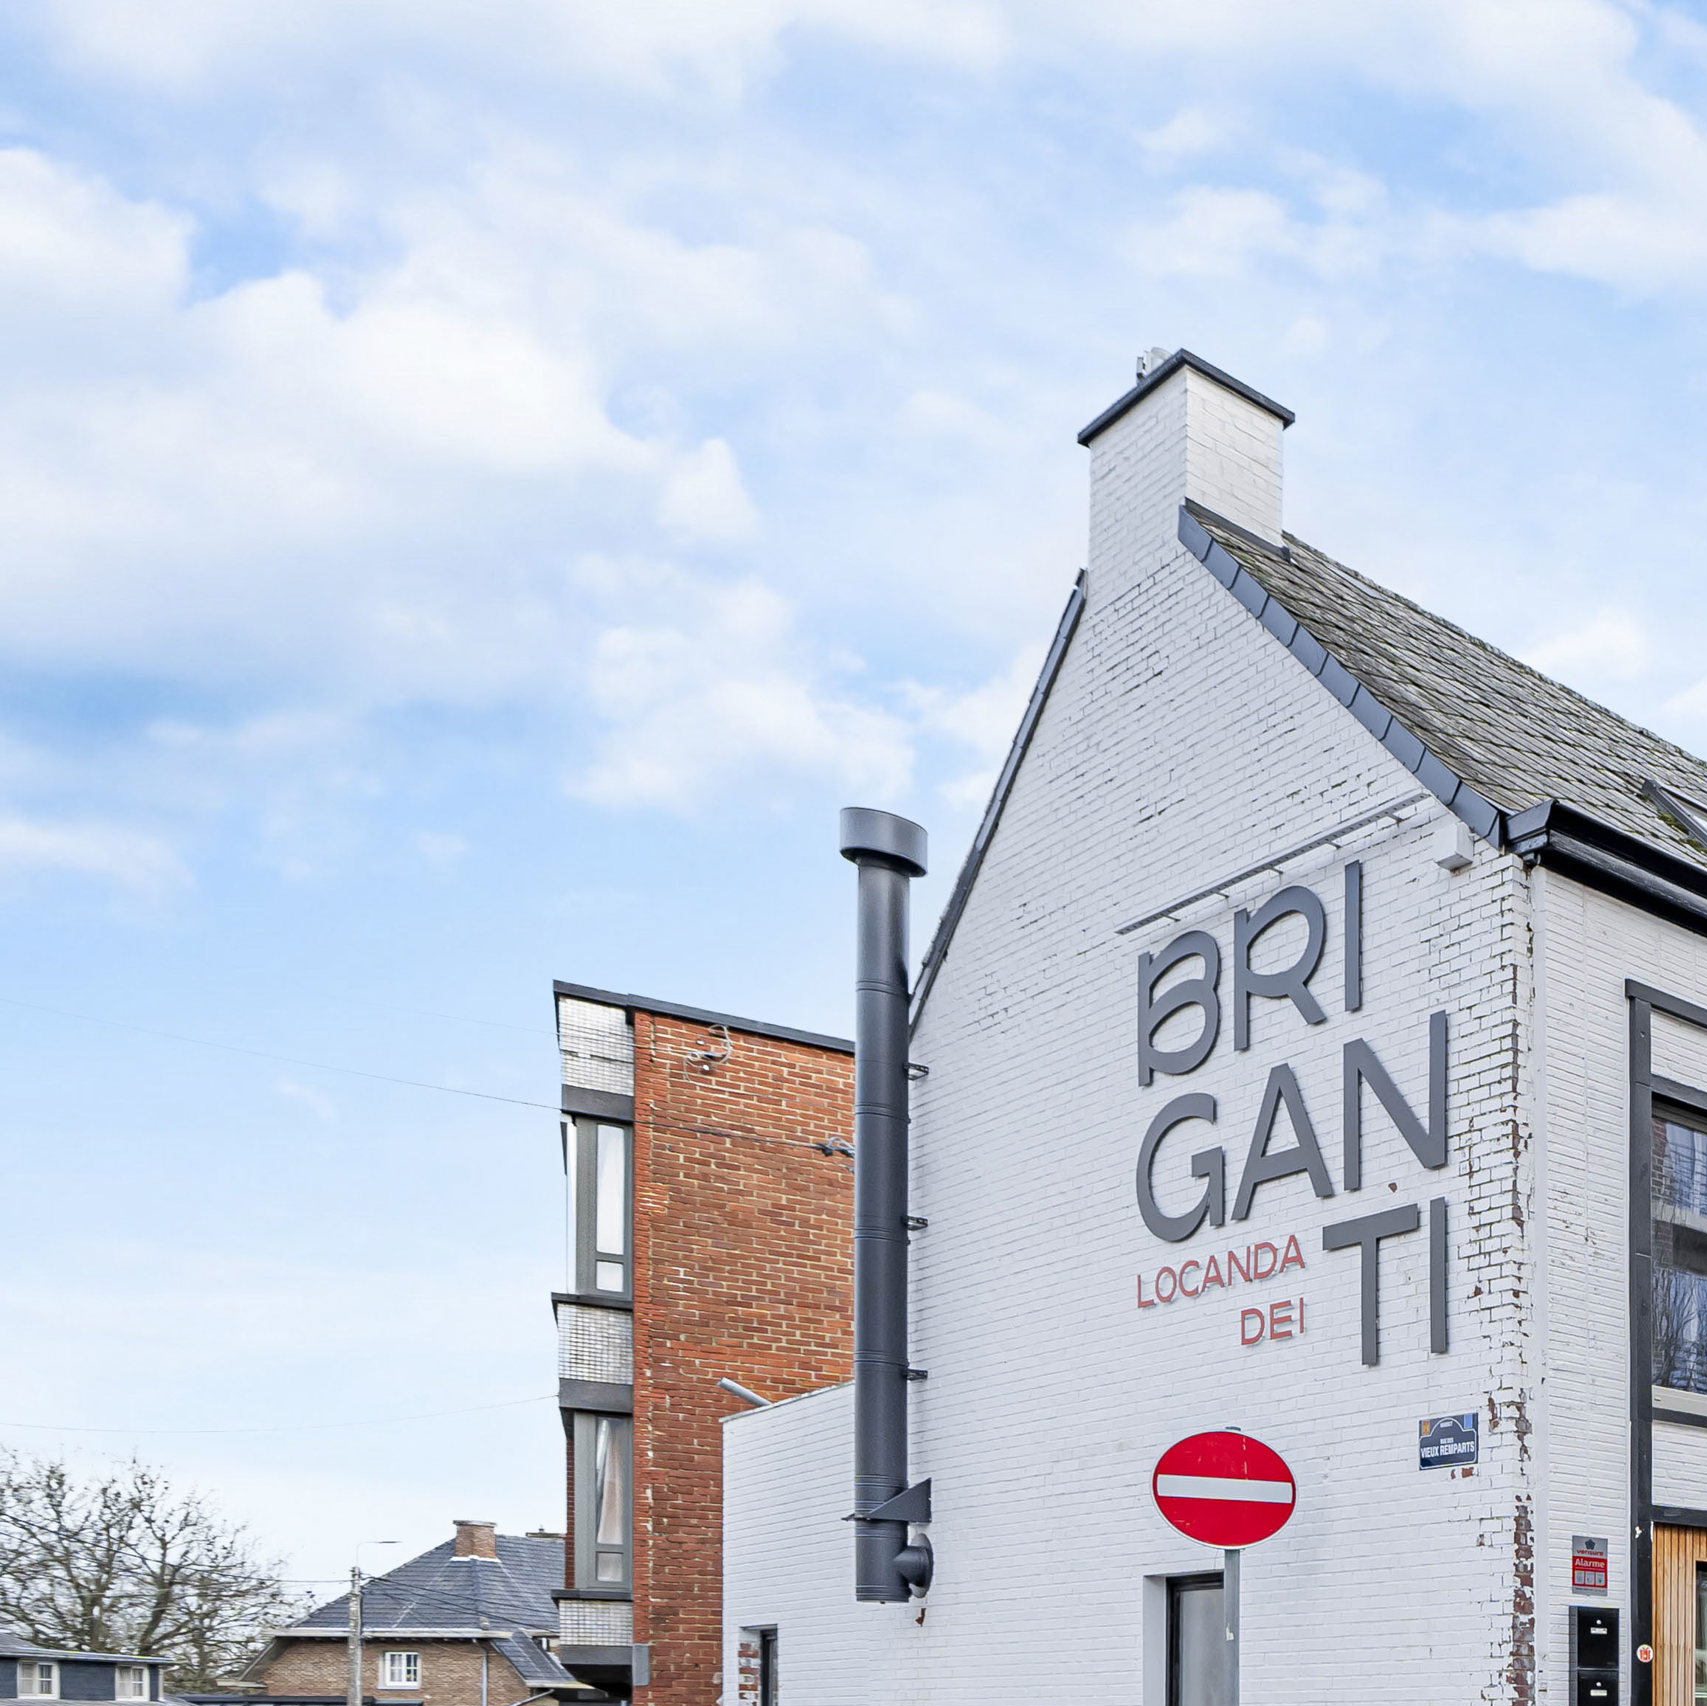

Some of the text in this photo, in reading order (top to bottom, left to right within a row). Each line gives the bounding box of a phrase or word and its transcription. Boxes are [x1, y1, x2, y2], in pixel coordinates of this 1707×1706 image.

[1137, 859, 1363, 1087] BRI
[1135, 1009, 1448, 1243] GAN
[1136, 1233, 1306, 1309] LOCANDA
[1322, 1195, 1447, 1366] TI
[1240, 1297, 1304, 1346] DEI
[1420, 1440, 1475, 1459] VIEUX REMPARTS
[1575, 1558, 1606, 1569] Alarme
